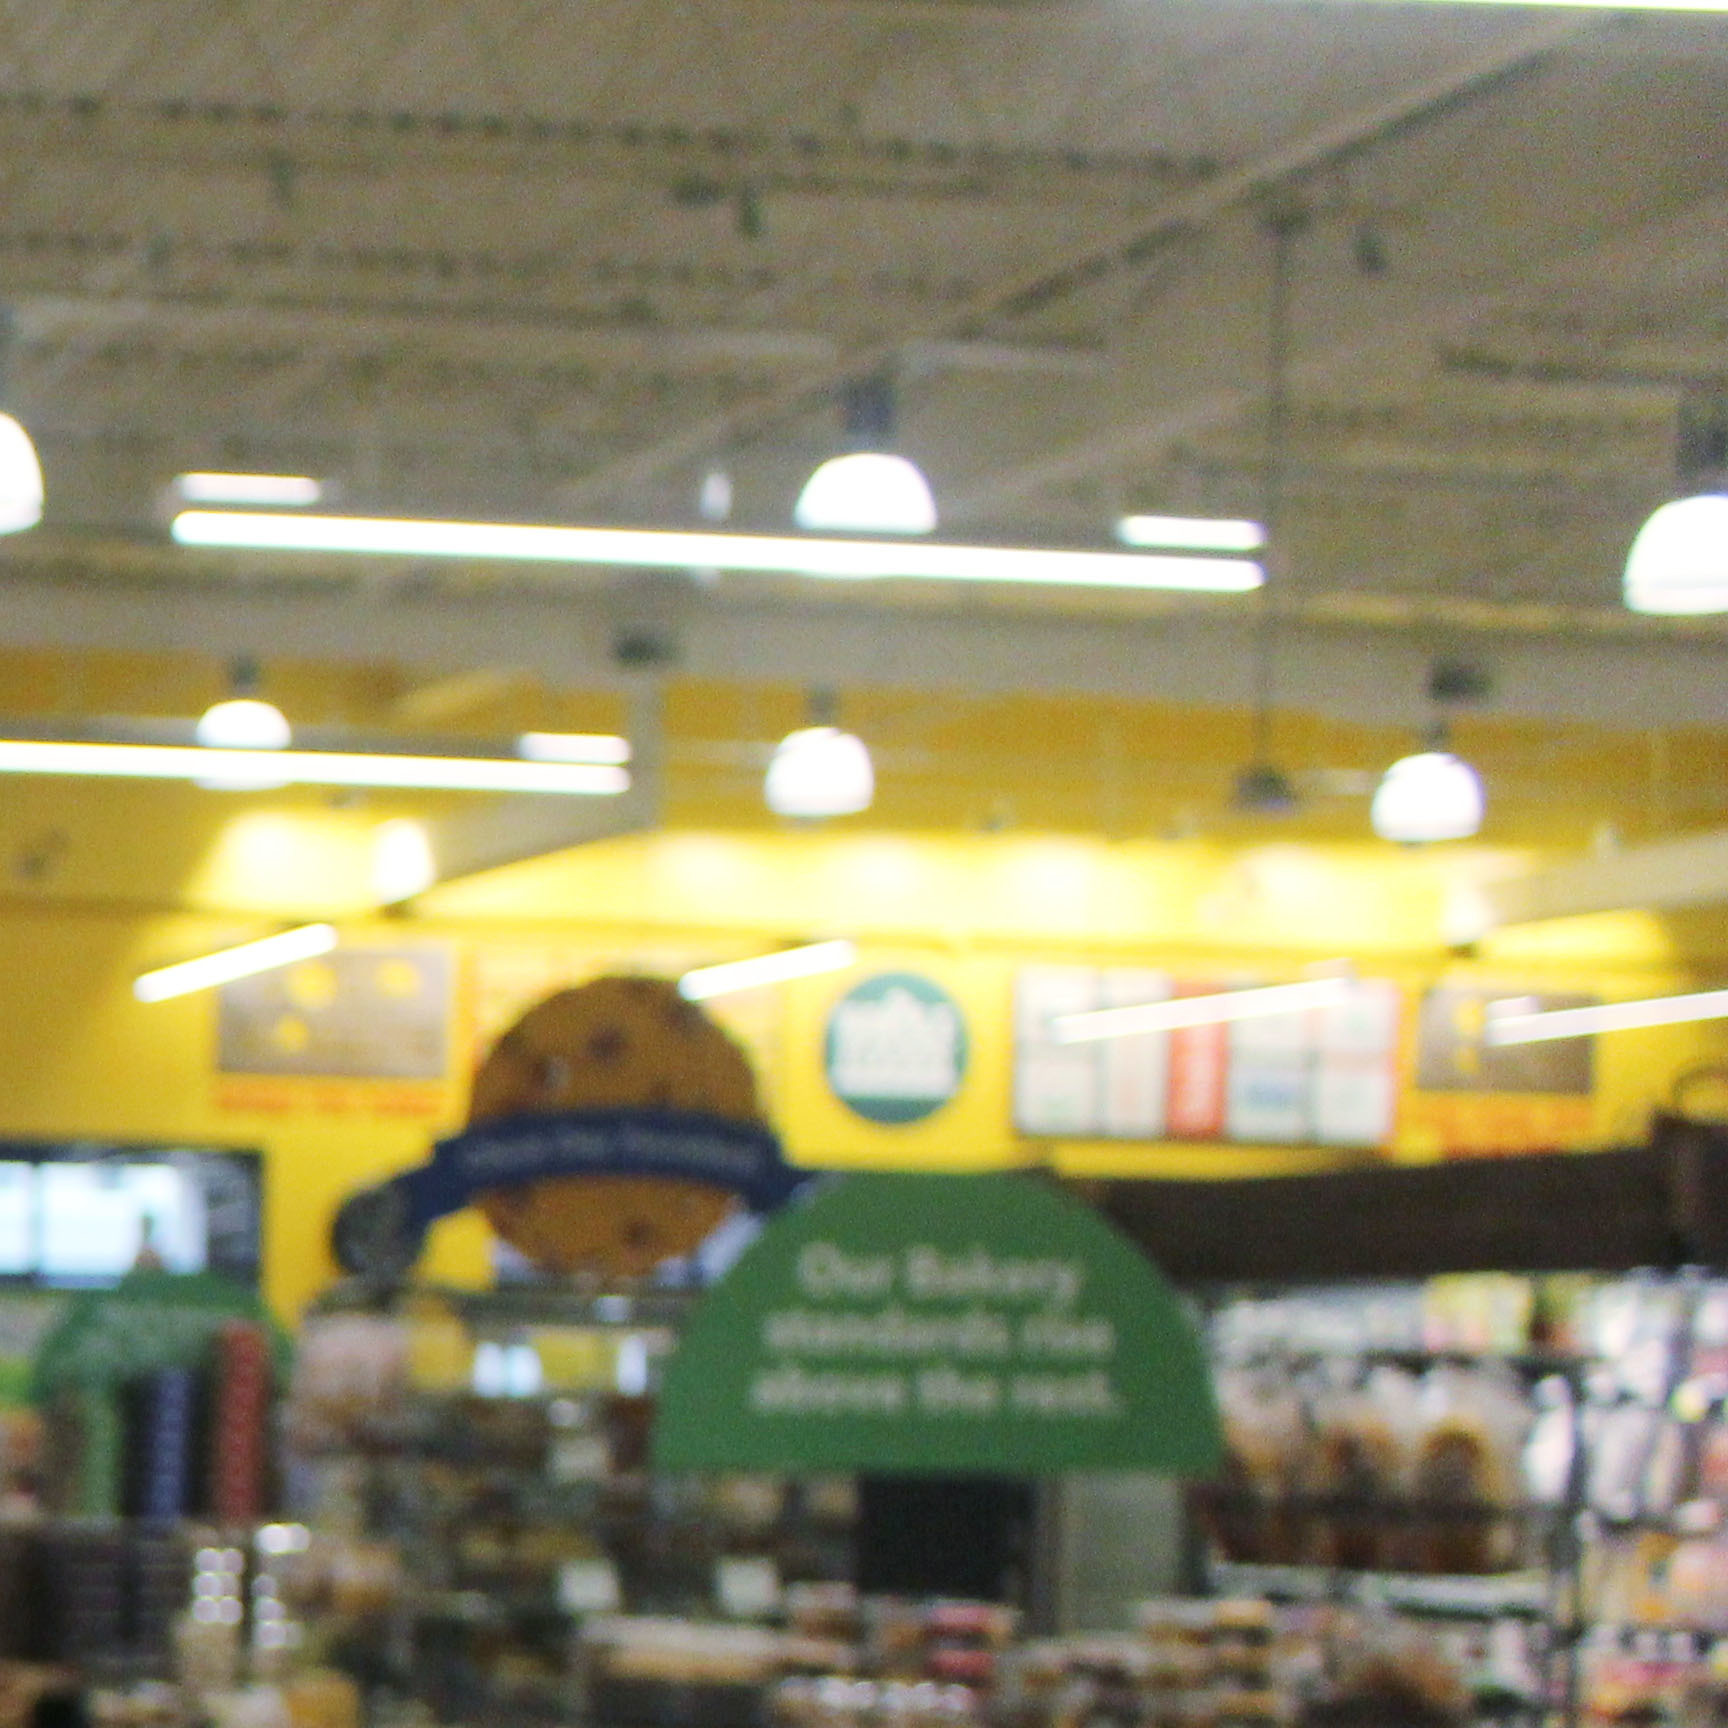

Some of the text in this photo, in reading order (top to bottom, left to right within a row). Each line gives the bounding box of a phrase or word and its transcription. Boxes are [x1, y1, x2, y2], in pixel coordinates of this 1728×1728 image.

[798, 1241, 1082, 1312] Our Bakery
[916, 1358, 1000, 1412] the
